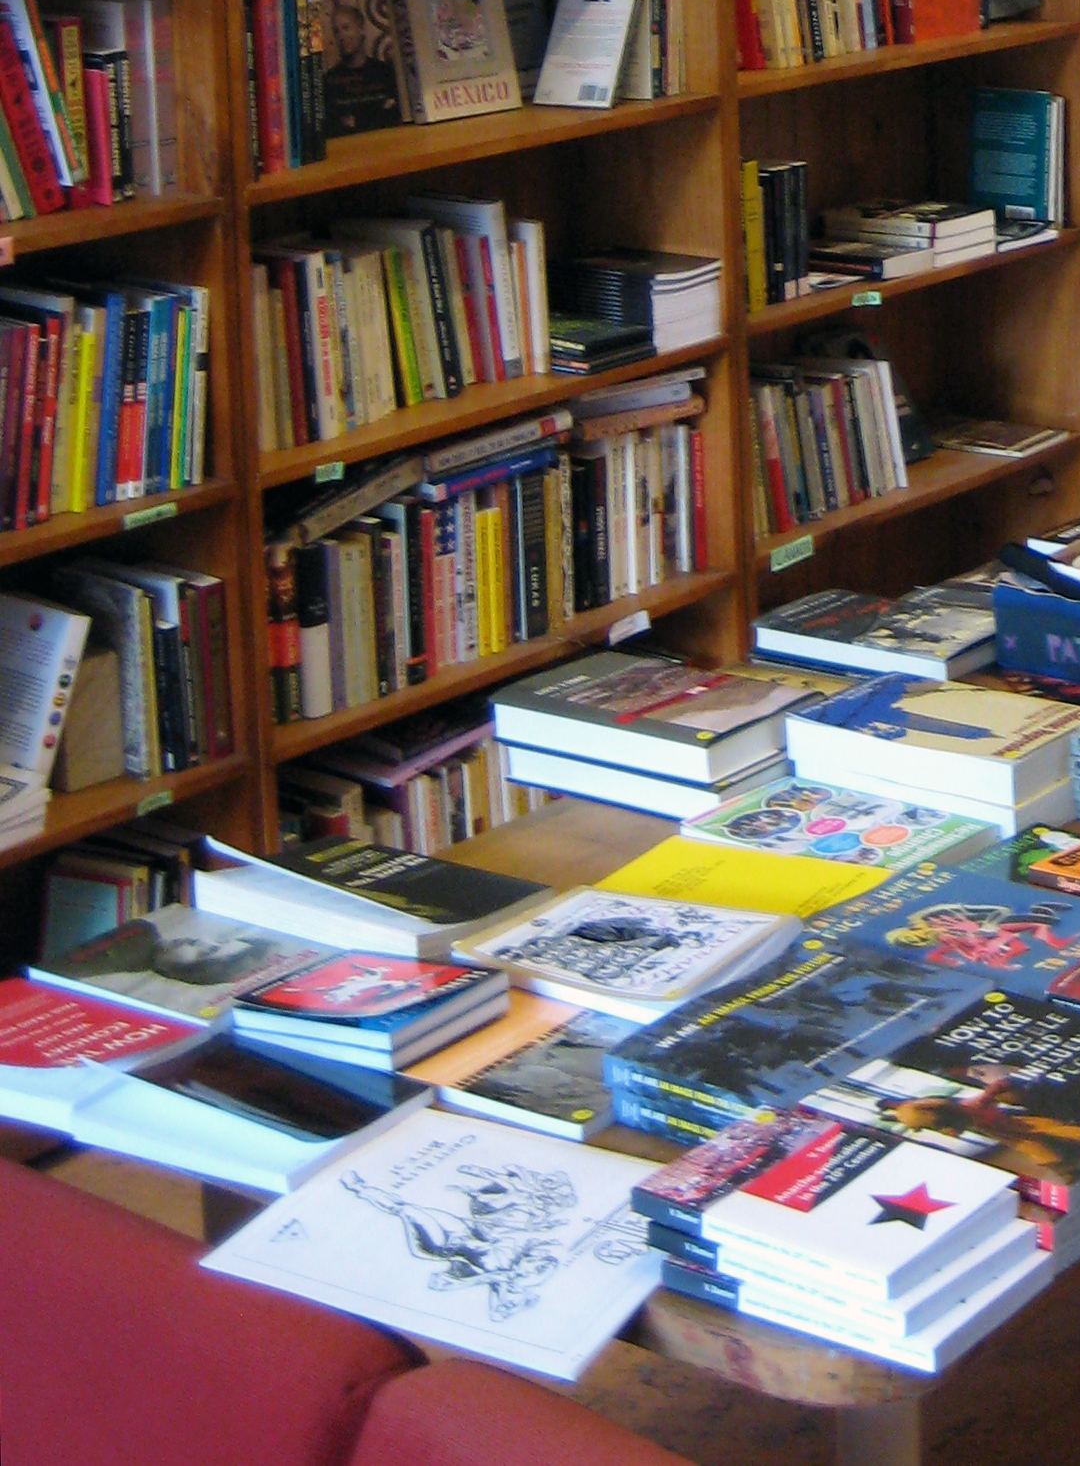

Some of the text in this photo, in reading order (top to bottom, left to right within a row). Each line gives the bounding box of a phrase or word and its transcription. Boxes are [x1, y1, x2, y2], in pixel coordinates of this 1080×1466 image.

[432, 79, 511, 111] MEXICO
[935, 1001, 1017, 1047] HOW TO
[970, 1013, 1034, 1050] MAKE
[808, 1177, 831, 1195] the
[844, 1139, 886, 1170] Century
